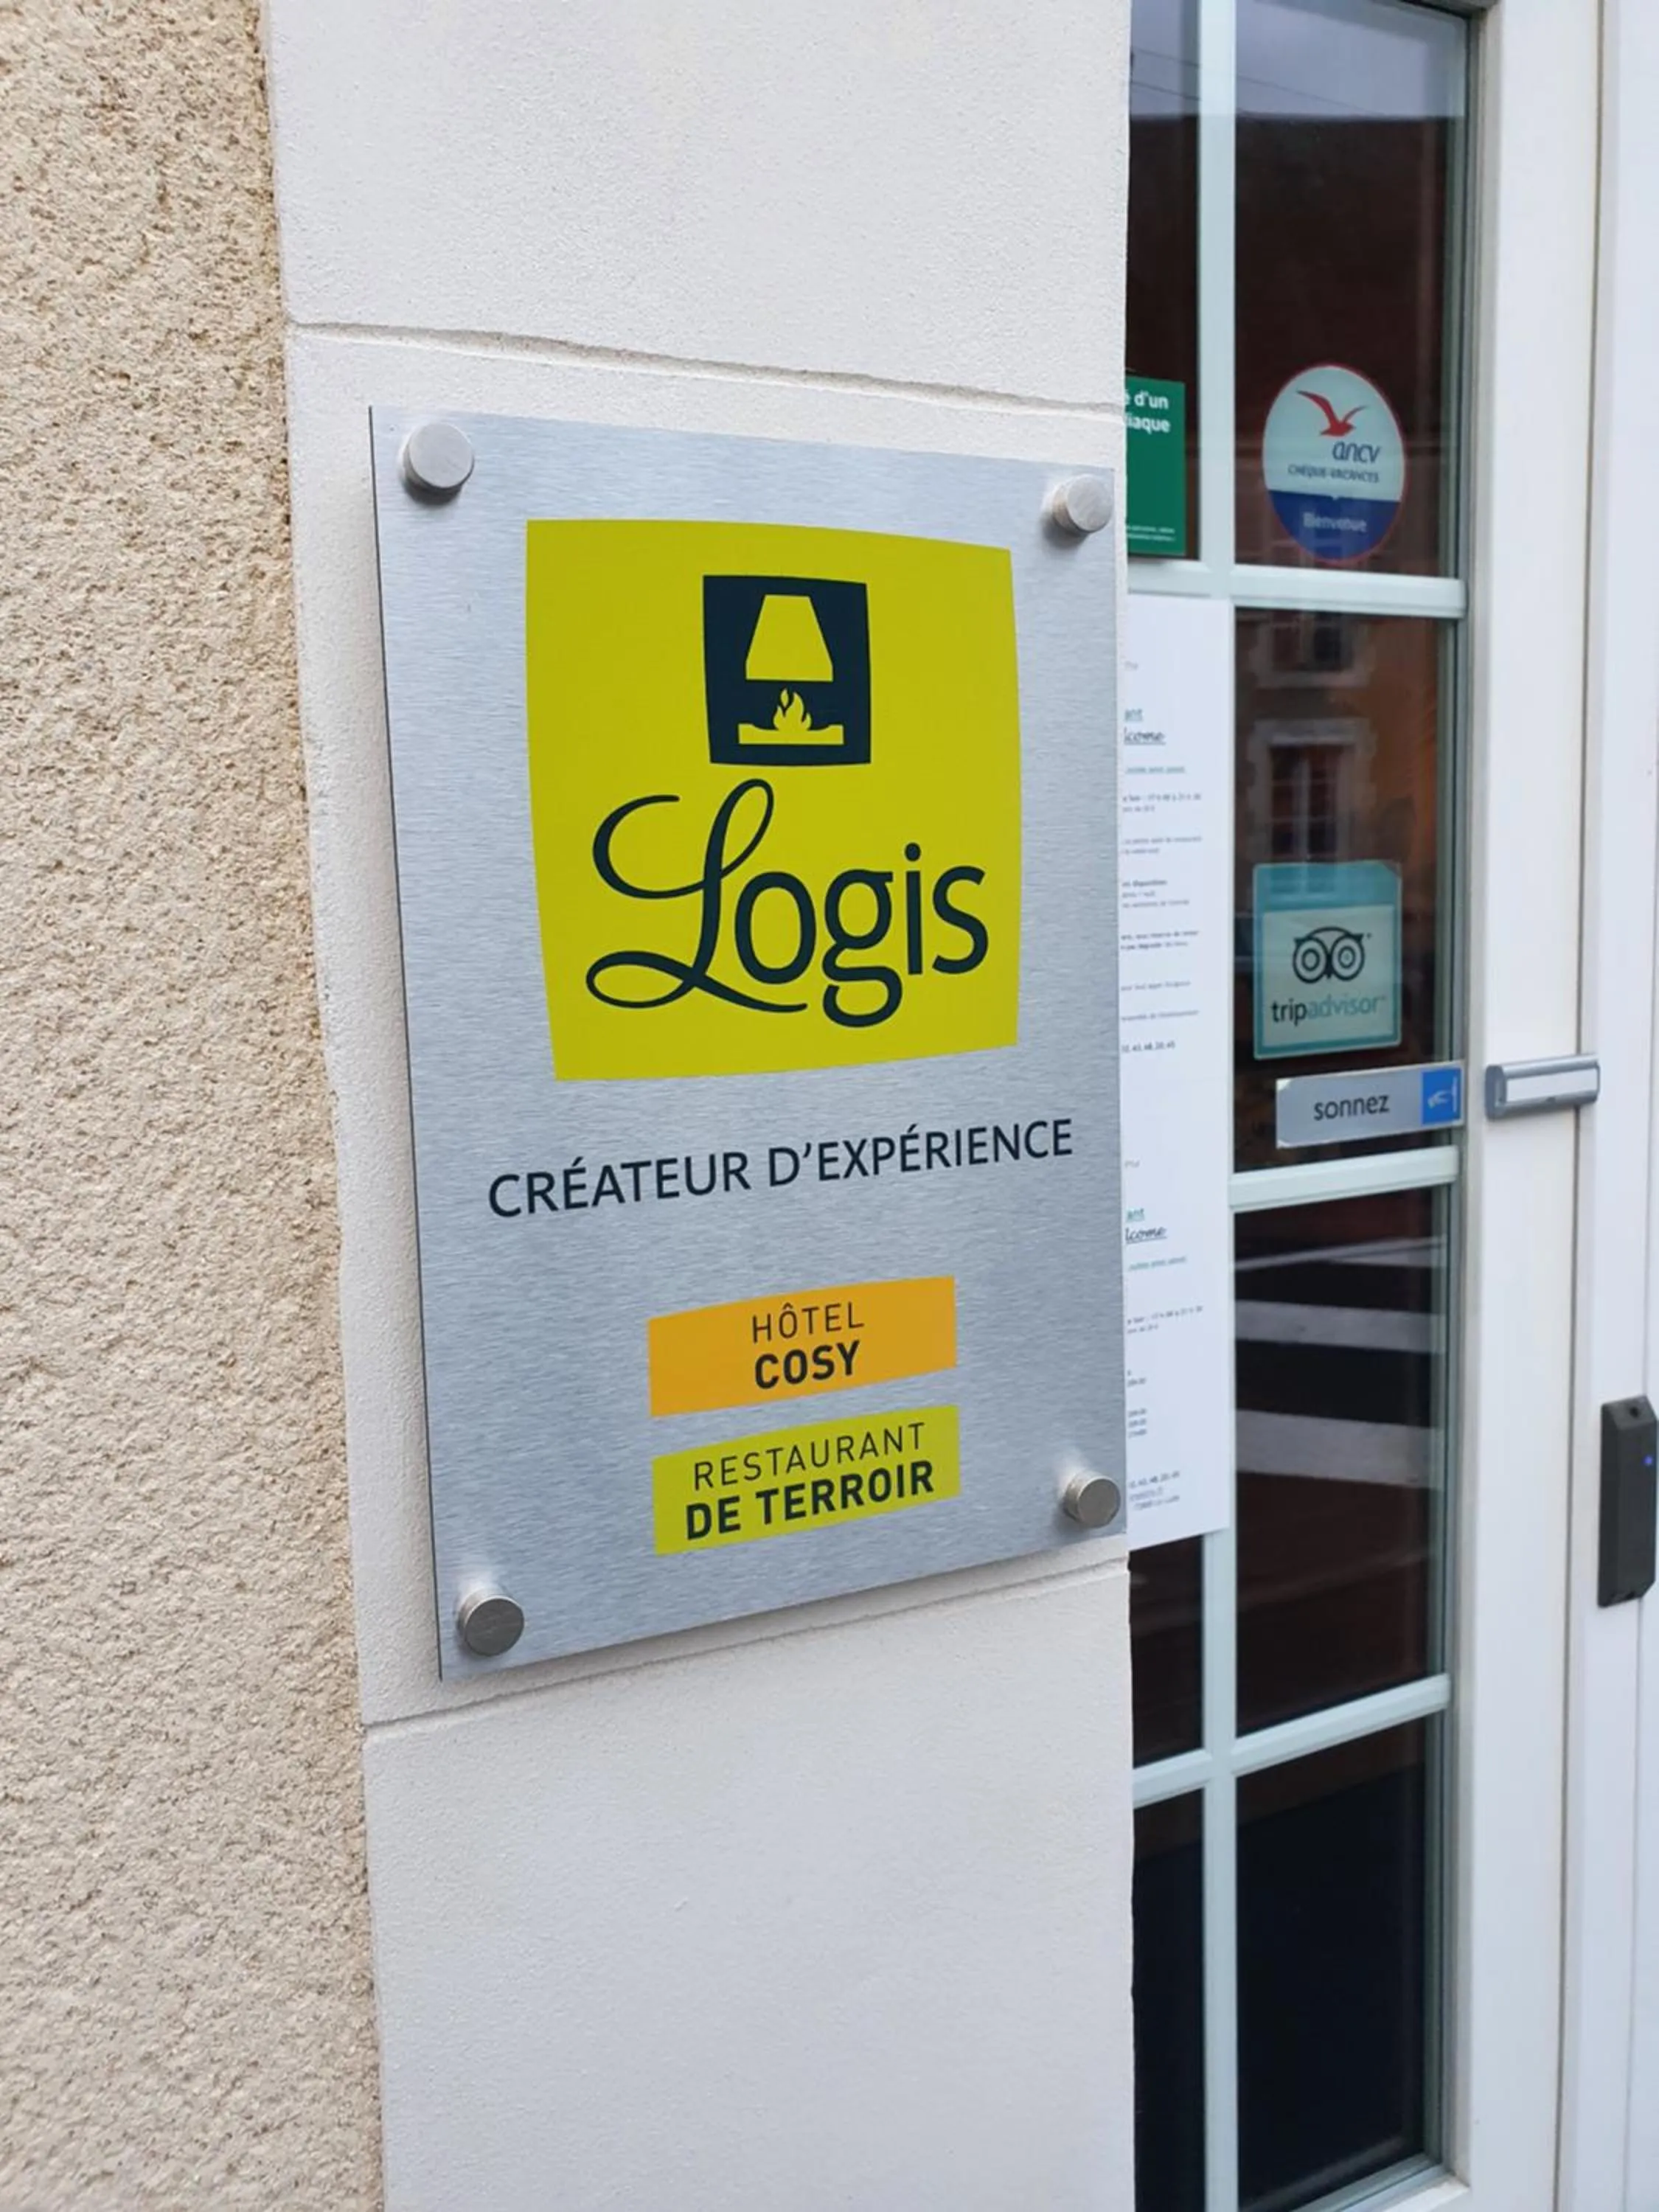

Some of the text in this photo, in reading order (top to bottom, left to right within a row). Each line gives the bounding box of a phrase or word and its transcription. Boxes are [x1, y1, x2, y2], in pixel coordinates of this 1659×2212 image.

[1134, 390, 1169, 409] d'un
[1332, 440, 1381, 464] ancv
[586, 778, 989, 1028] Logis
[1271, 994, 1380, 1026] tripadvisor
[1313, 1094, 1389, 1121] sonnez
[488, 1119, 1074, 1218] CRÉATEUR D'EXPÉRIENCE
[752, 1302, 864, 1343] HÔTEL
[754, 1340, 860, 1389] COSY
[694, 1422, 925, 1491] RESTAURANT
[686, 1460, 934, 1540] DE TERROIR
